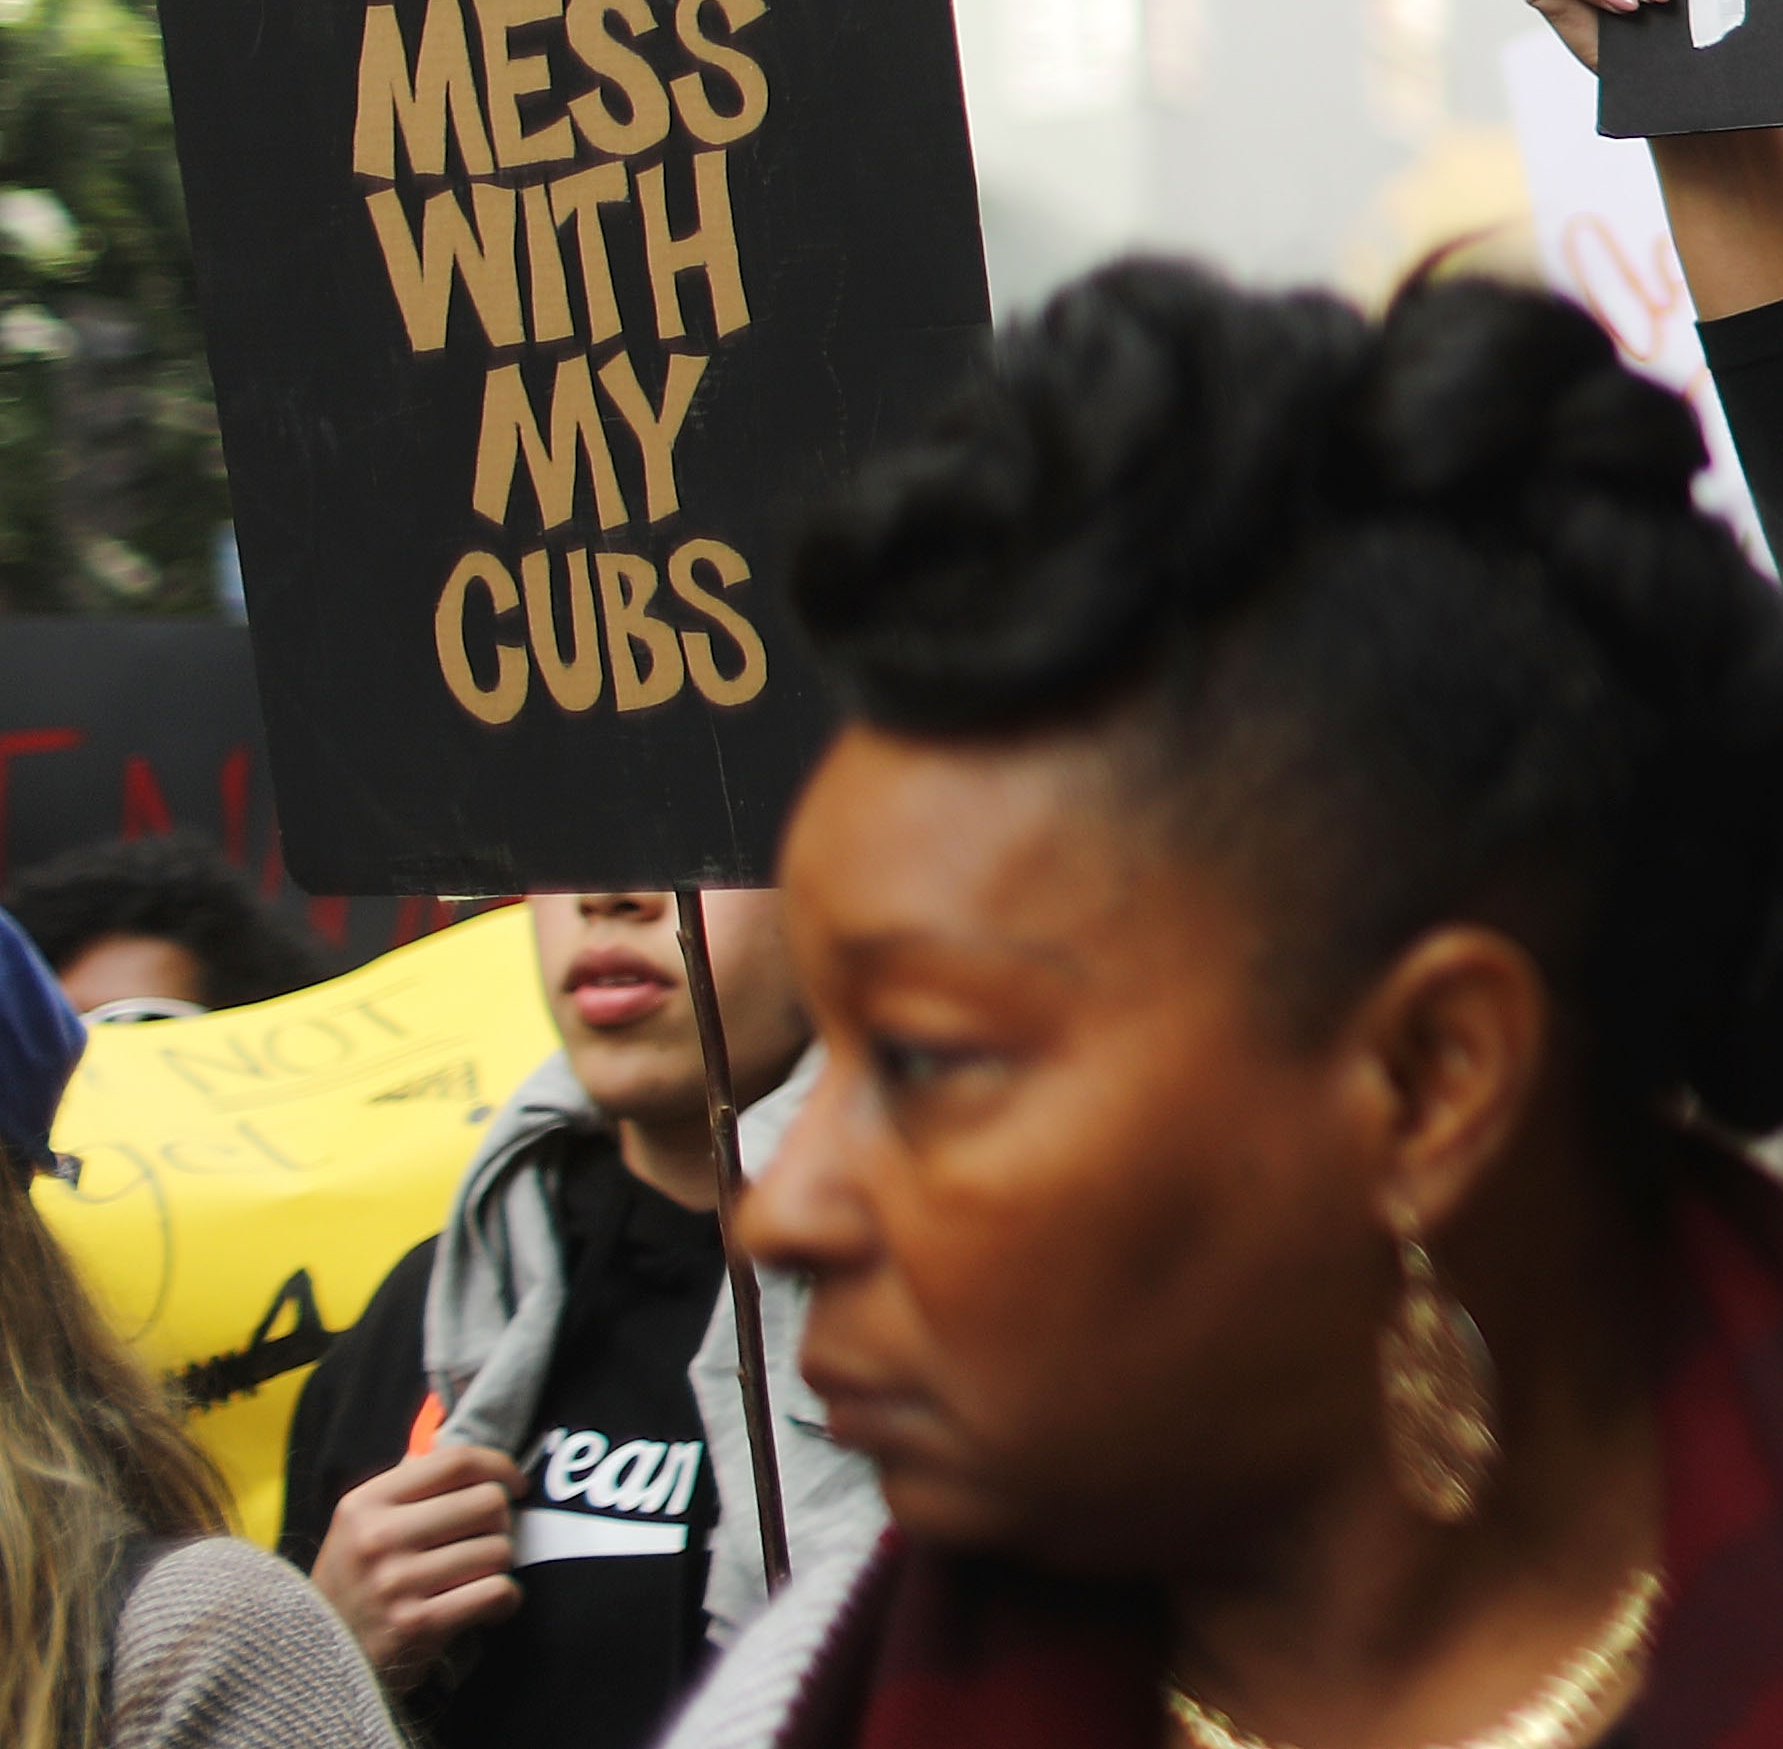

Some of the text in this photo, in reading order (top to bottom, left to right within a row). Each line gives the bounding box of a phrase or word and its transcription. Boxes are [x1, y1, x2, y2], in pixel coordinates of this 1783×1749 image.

[364, 149, 752, 353] WITH
[471, 350, 709, 531] MY
[434, 538, 768, 724] CUBS
